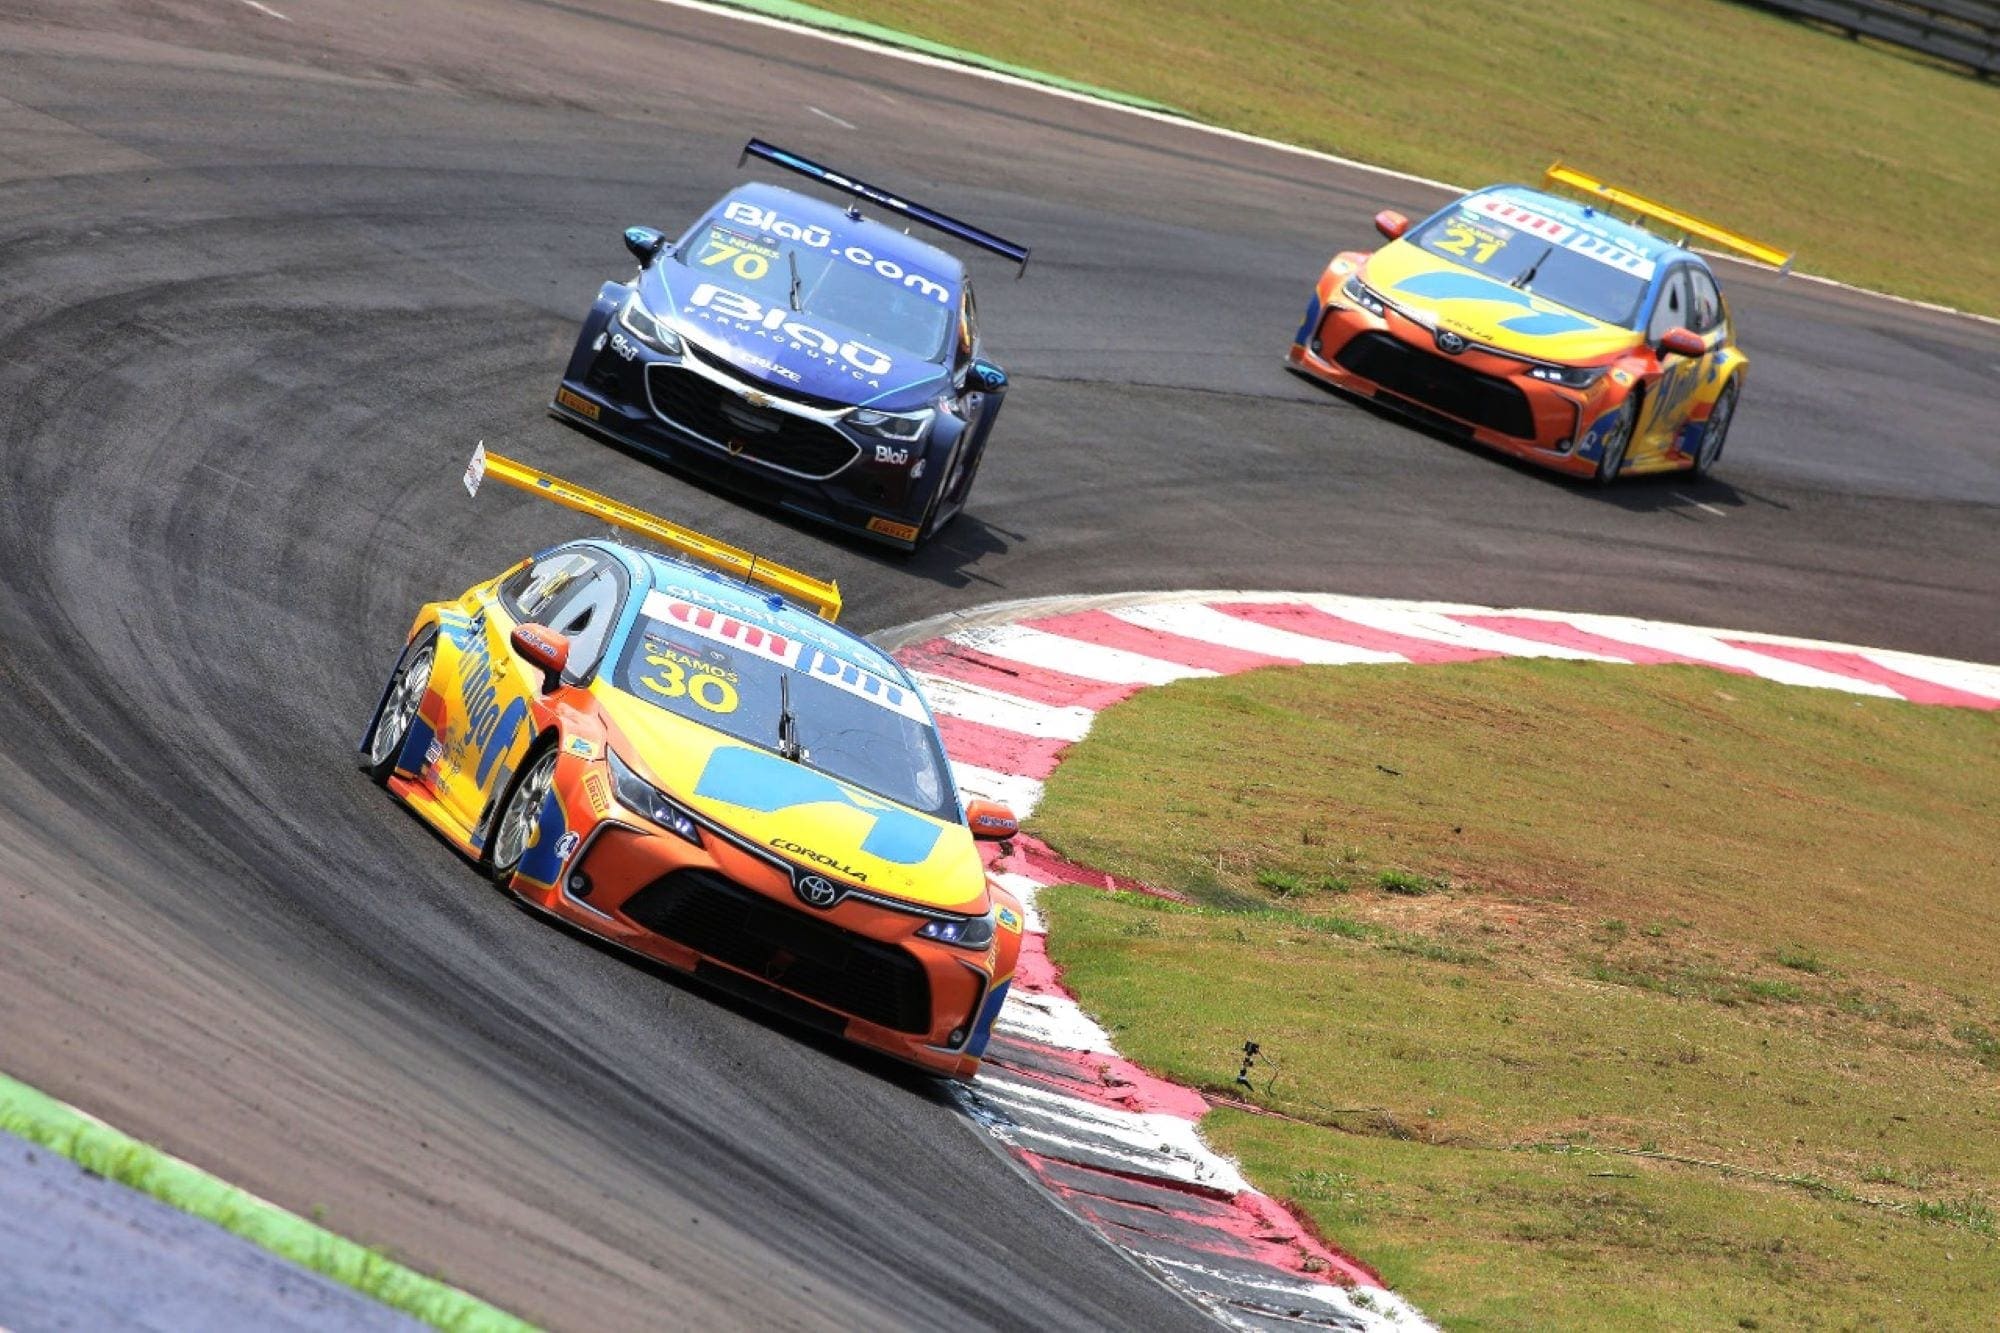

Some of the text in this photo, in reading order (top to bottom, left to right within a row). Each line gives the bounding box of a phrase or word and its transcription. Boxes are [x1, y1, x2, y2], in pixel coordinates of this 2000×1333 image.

[700, 240, 769, 279] 70
[1433, 227, 1497, 264] 21
[644, 642, 739, 682] C.RAMOS
[640, 654, 740, 714] 30
[769, 838, 868, 883] COROLLA
